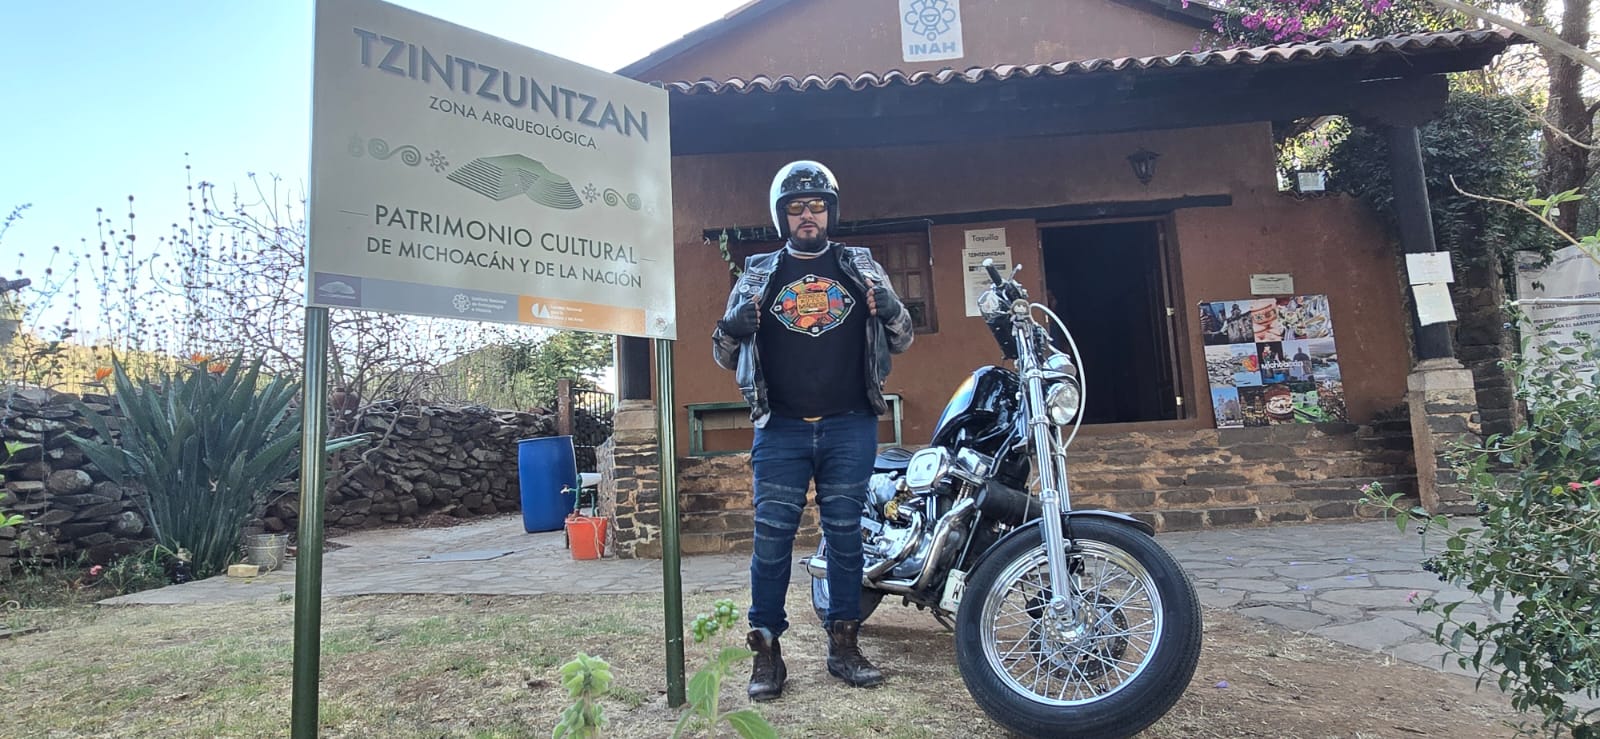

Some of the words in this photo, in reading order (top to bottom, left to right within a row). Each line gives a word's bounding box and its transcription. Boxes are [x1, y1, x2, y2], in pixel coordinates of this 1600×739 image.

[909, 41, 956, 55] INAH
[352, 27, 648, 142] TZINTZUNTZAN
[429, 96, 477, 119] ZONA
[481, 110, 597, 149] ARQUEOLÓGICA
[375, 204, 532, 247] PATRIMONIO
[540, 232, 638, 265] CULTURAL
[972, 233, 999, 243] Taquilla
[367, 236, 392, 255] DE
[398, 241, 514, 271] MICHOACÁN
[519, 258, 530, 273] Y
[535, 261, 555, 277] DE
[559, 264, 578, 279] LA
[582, 267, 642, 288] NACIÓN
